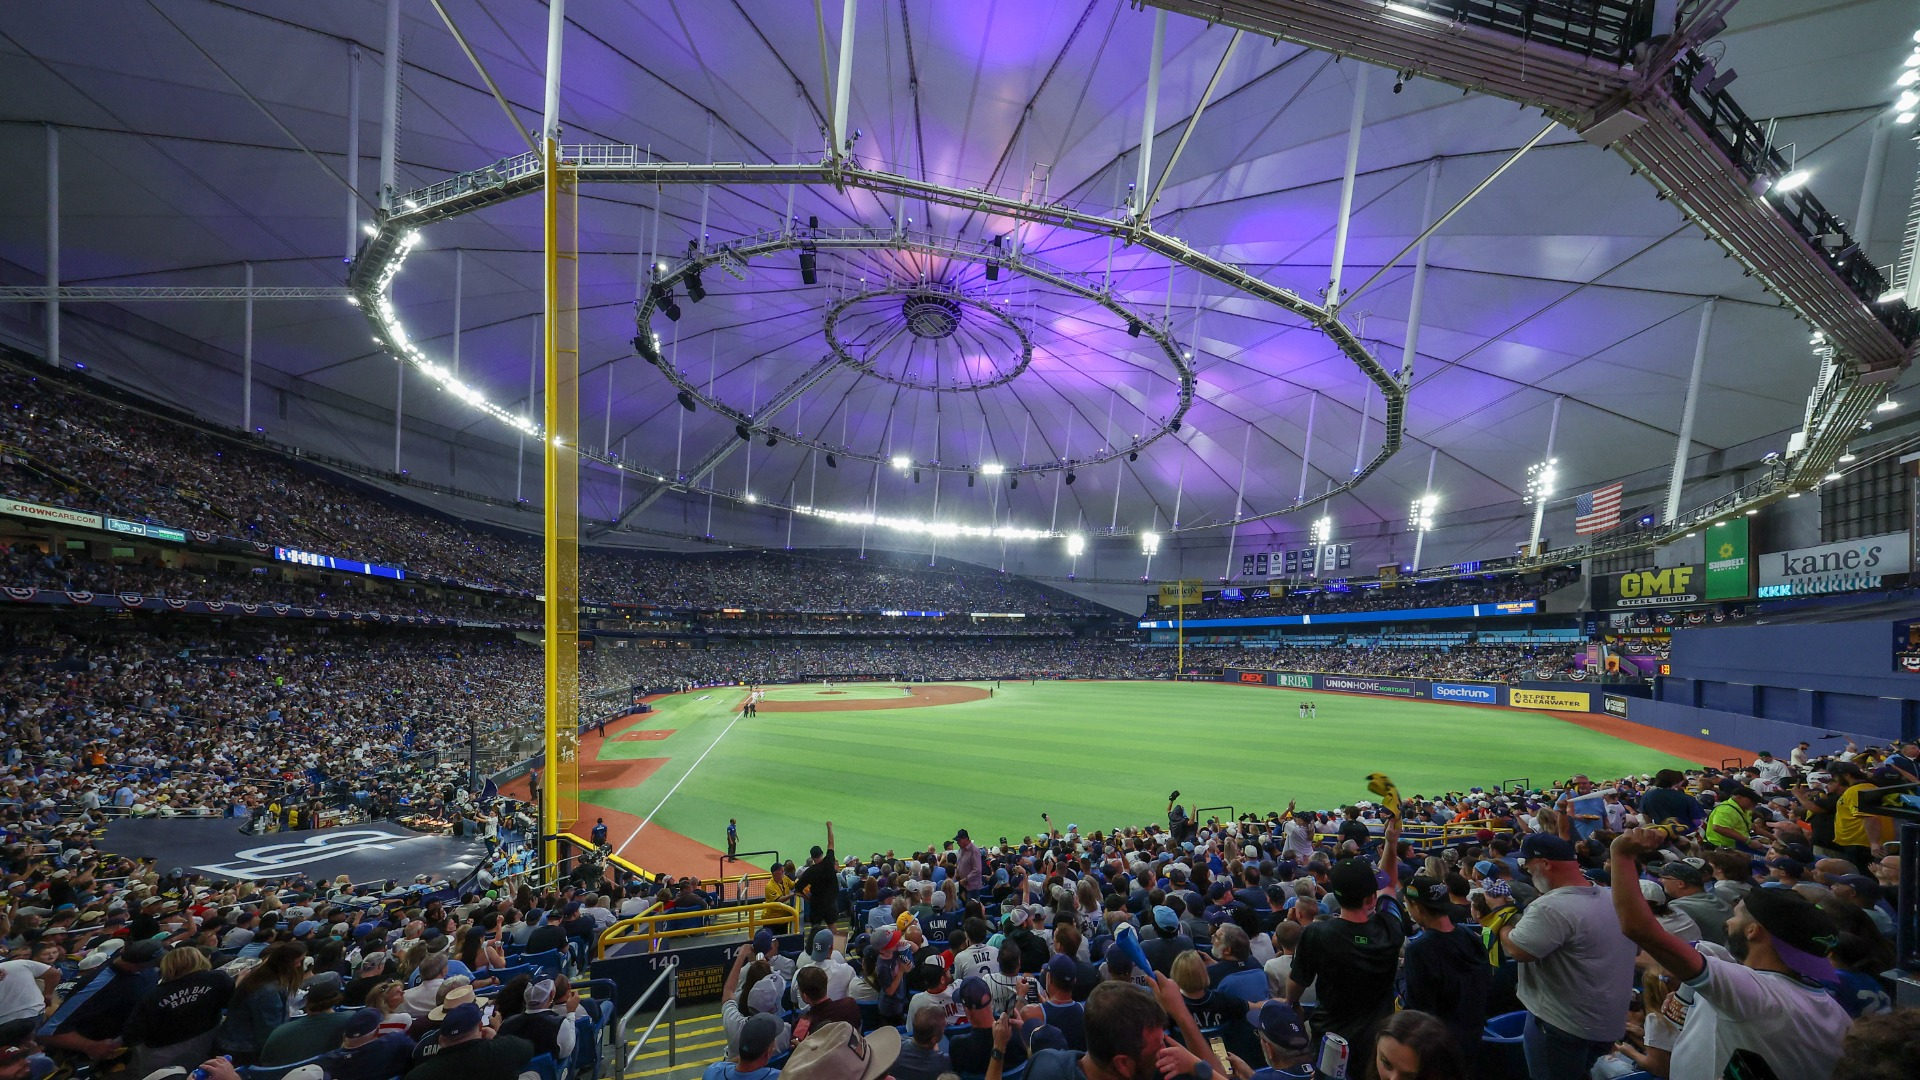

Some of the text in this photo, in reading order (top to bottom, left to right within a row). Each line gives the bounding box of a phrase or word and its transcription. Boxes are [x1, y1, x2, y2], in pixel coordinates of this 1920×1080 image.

[13, 504, 96, 524] CROWNCARS.COM
[1782, 546, 1882, 576] kane's
[1620, 567, 1694, 598] GMF
[1656, 595, 1691, 604] GROUP
[1240, 672, 1263, 682] DEX
[1287, 675, 1309, 687] RIPA
[1379, 686, 1411, 694] MORTGAGE
[1437, 686, 1486, 698] Spectrum
[1523, 698, 1580, 707] CLEARWATER
[649, 954, 680, 970] 140
[678, 974, 722, 988] WATCH OUT
[192, 985, 212, 995] BAY
[170, 994, 199, 1008] RAYS
